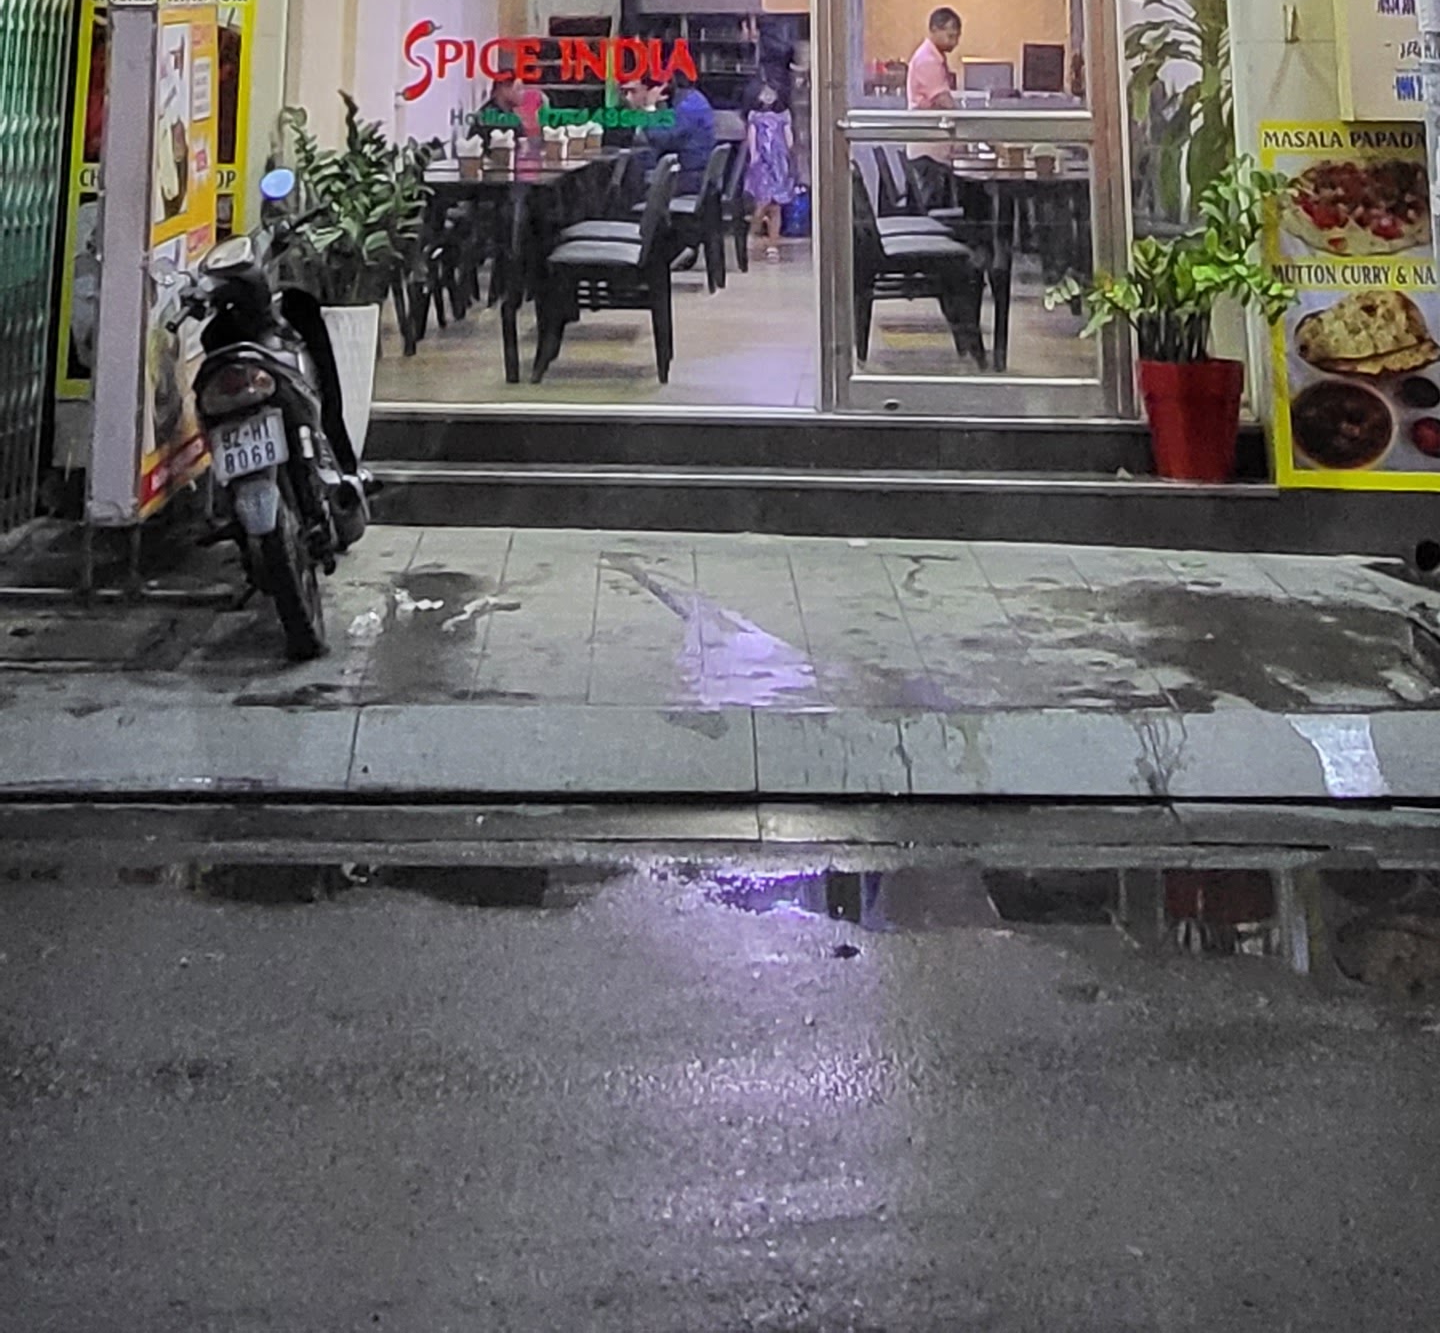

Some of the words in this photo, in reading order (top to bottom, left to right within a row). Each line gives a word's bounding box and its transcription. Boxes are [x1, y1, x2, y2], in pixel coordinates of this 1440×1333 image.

[400, 19, 543, 101] SPICE
[559, 37, 697, 83] INDIA
[1263, 131, 1344, 148] MASALA
[1272, 263, 1337, 284] MUTTON
[1341, 264, 1390, 284] CURRY
[1396, 266, 1407, 284] &
[1413, 264, 1437, 285] NA
